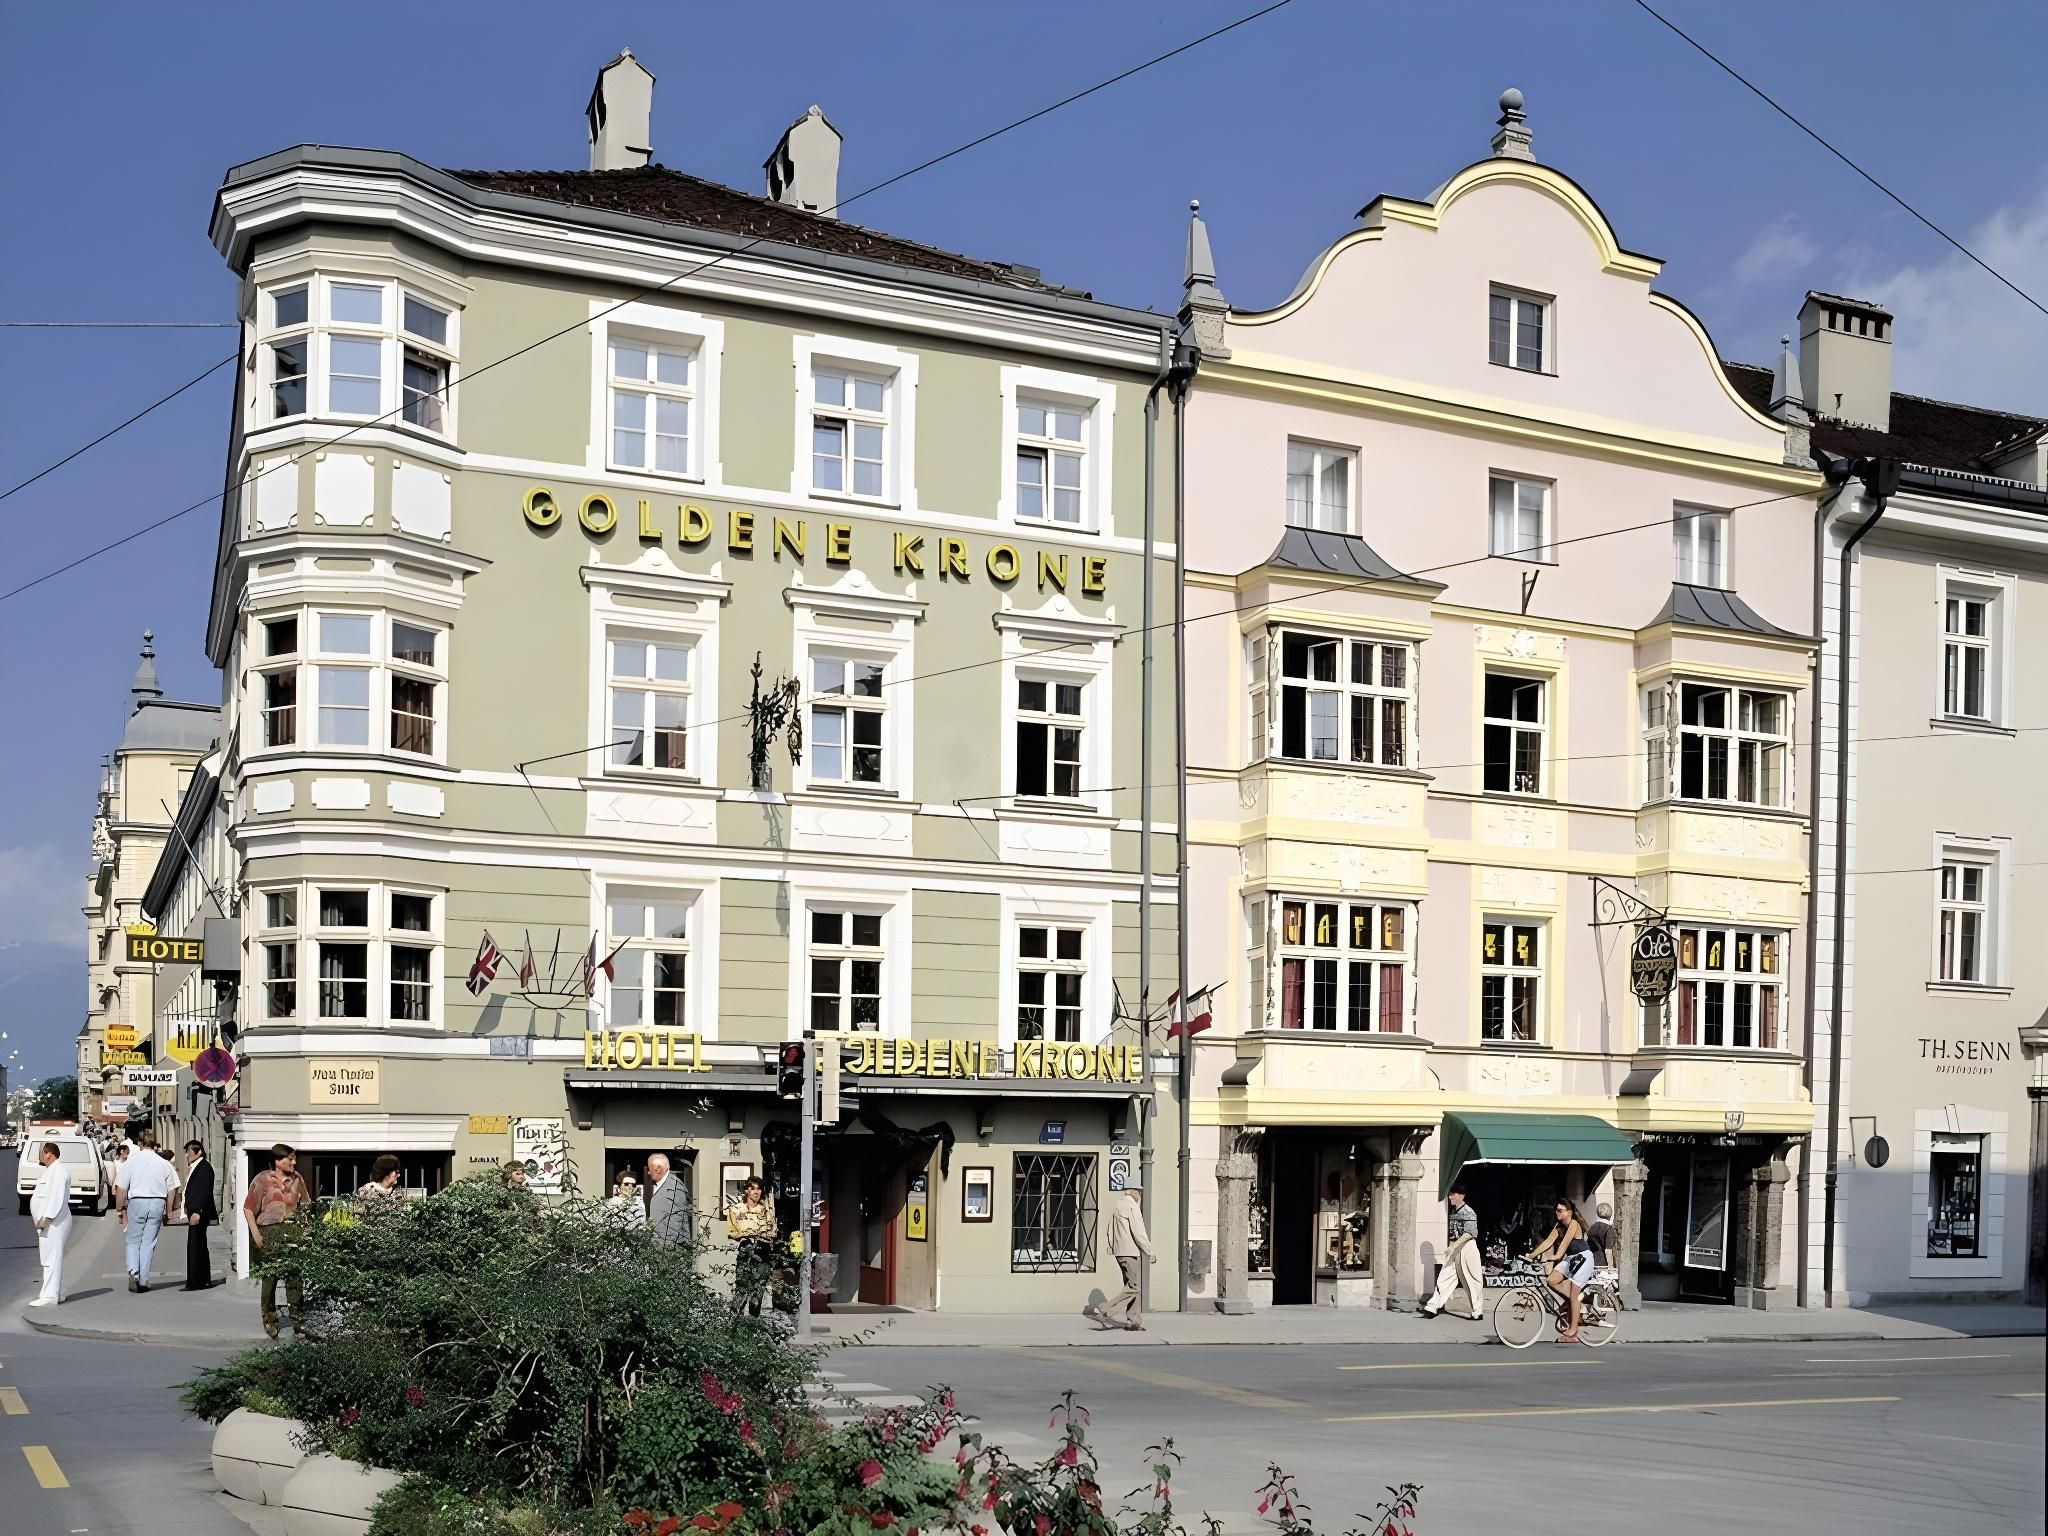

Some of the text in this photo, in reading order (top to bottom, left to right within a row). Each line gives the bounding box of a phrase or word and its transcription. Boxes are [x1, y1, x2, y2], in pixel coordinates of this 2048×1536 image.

[522, 486, 1107, 592] GOLDENE KRONE
[584, 1030, 1143, 1083] HOTEL OLDENE KRONE
